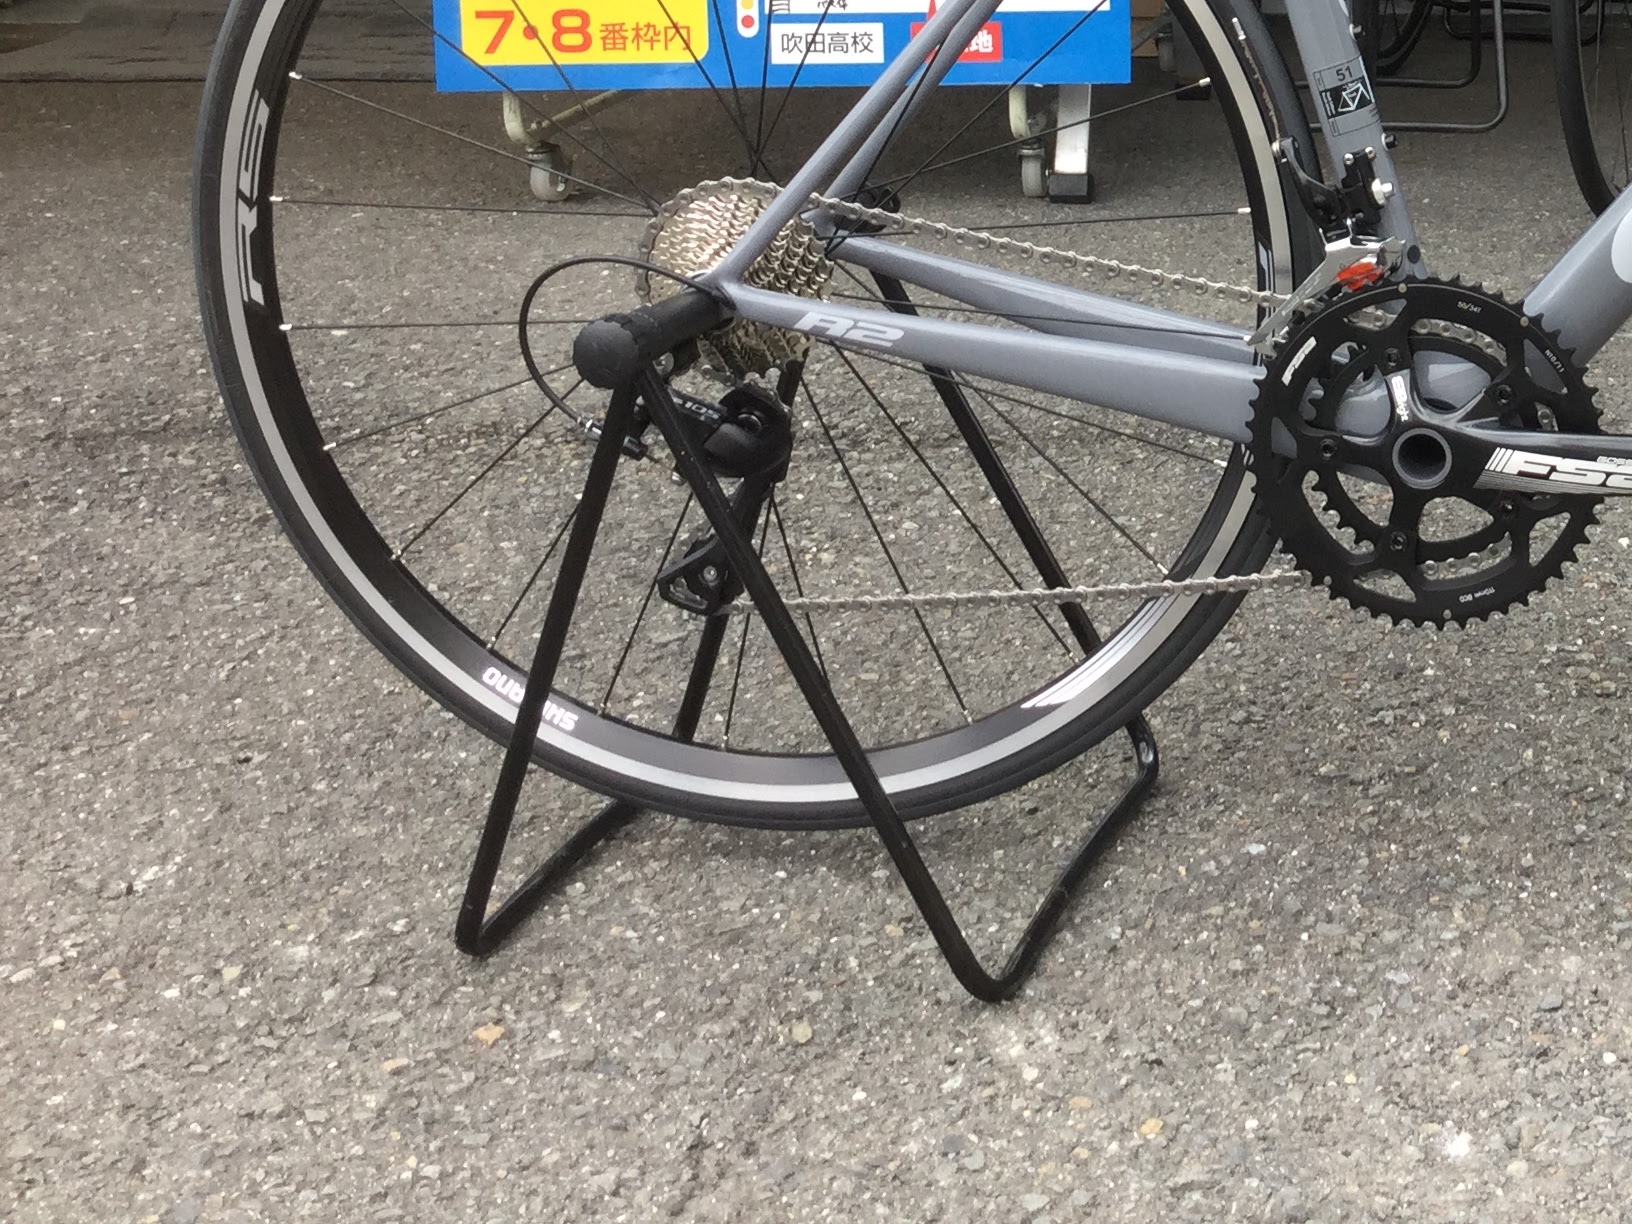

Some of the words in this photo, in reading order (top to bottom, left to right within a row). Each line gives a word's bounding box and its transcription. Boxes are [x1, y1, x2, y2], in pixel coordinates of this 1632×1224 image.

[781, 32, 873, 55] 吹田高校
[1336, 65, 1353, 82] 51
[482, 666, 579, 731] SHIANO
